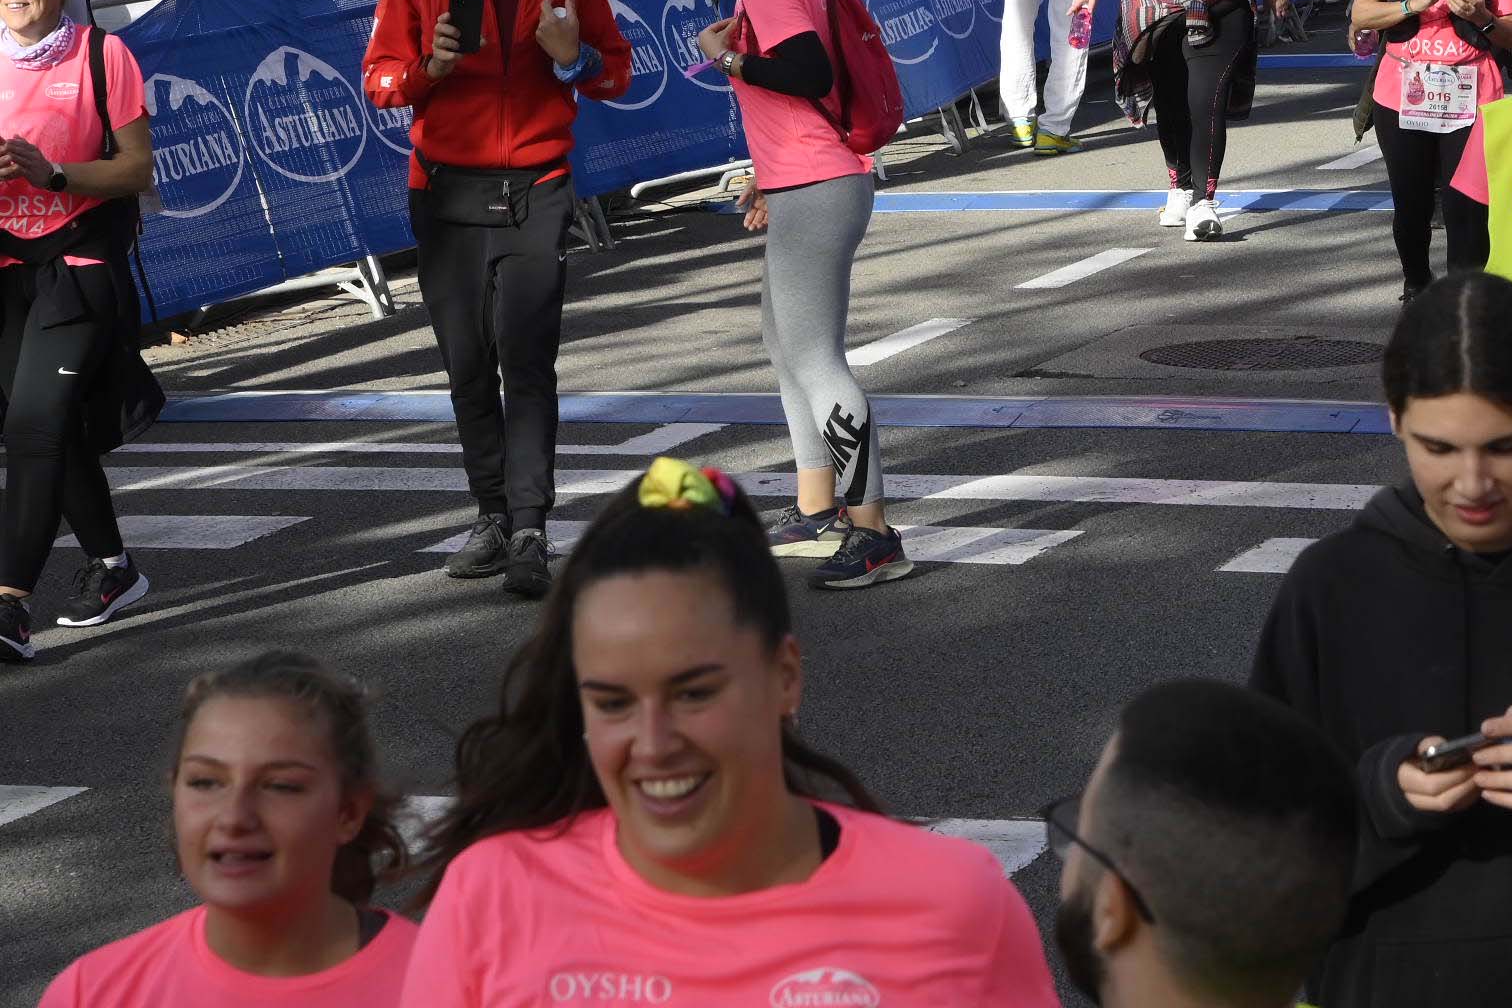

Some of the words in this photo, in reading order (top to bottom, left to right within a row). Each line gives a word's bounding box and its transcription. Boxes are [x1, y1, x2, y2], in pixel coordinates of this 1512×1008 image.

[1427, 91, 1451, 102] 016
[256, 103, 362, 154] ASTURIANA
[551, 972, 672, 1005] OYSHO
